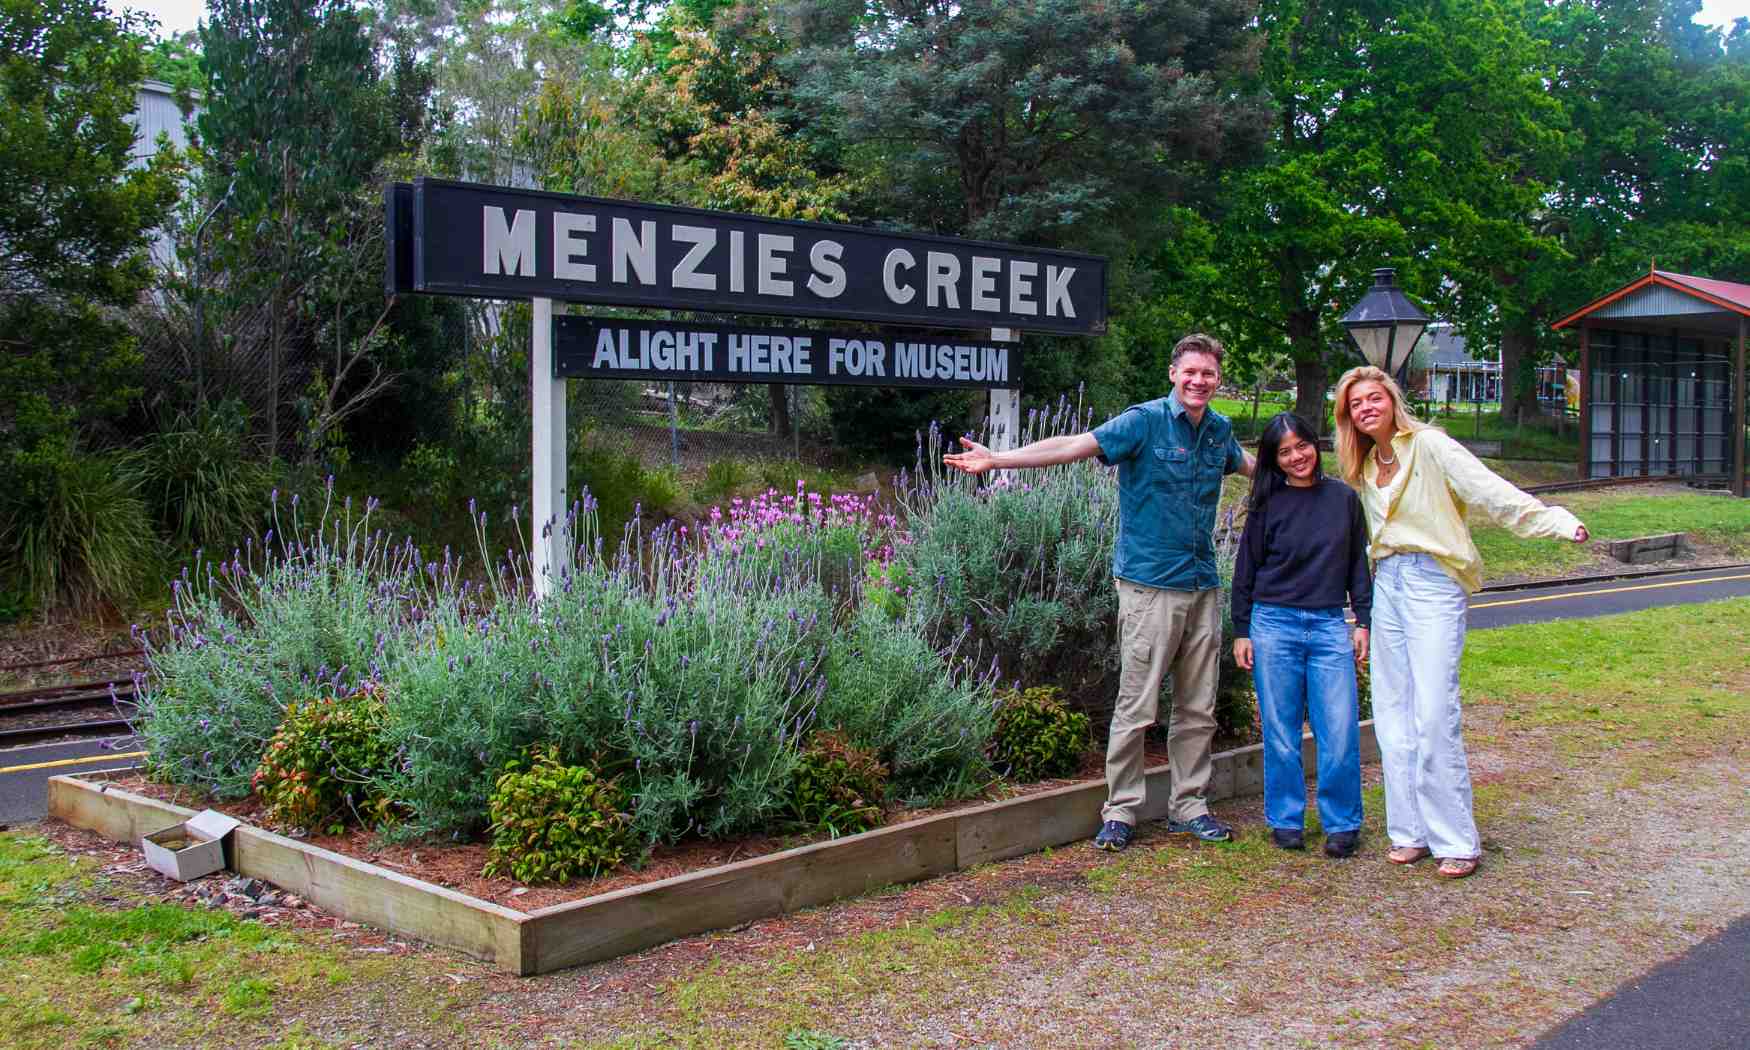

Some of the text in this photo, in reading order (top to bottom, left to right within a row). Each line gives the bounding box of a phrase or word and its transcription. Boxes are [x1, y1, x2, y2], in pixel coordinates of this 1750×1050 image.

[483, 206, 1076, 318] MENZIES CREEK
[592, 328, 1009, 382] ALIGHT HERE FOR MUSEUM
